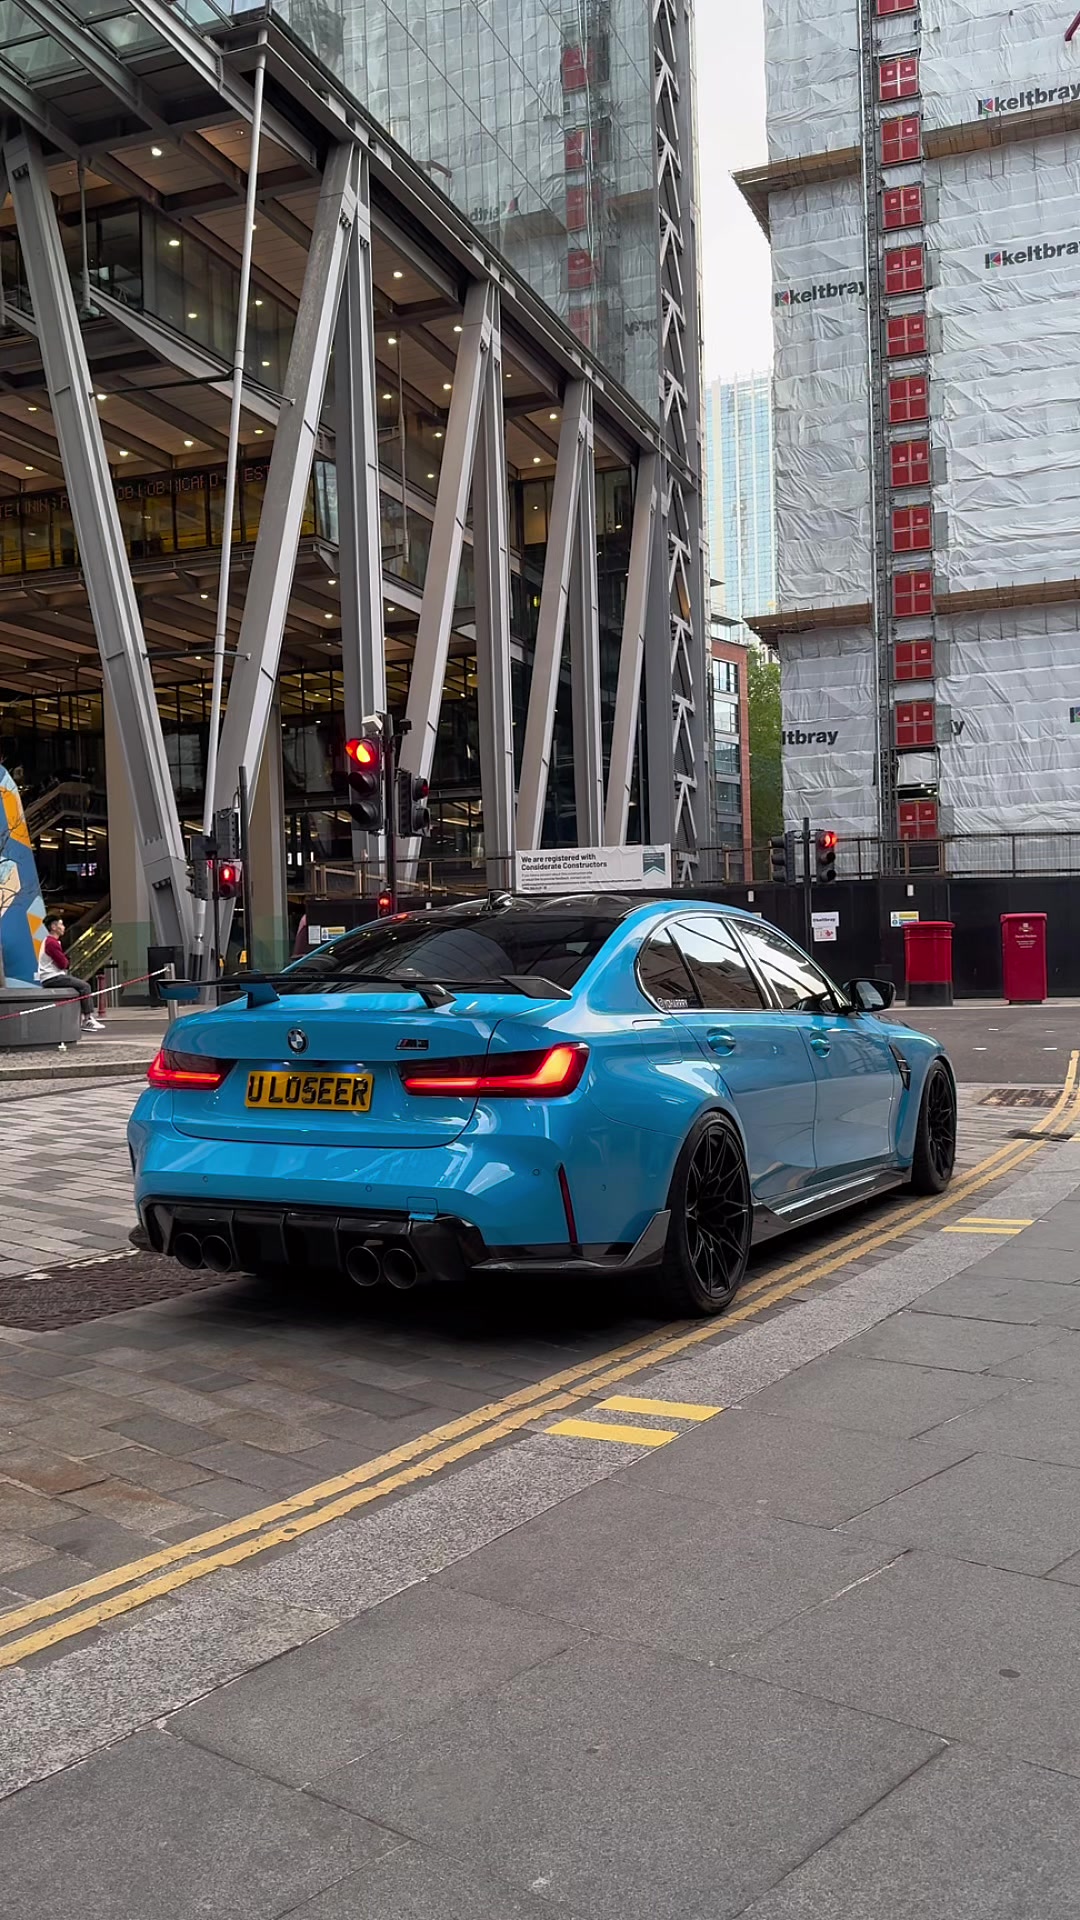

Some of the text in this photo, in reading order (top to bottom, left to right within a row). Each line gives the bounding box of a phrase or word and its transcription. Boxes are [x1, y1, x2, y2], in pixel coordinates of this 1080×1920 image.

[994, 83, 1080, 113] keltbray
[1002, 240, 1080, 266] keltbra
[789, 280, 865, 304] keltbray
[782, 730, 838, 746] ltbray
[521, 861, 607, 871] Considerate Constructors
[545, 854, 580, 863] registered
[581, 853, 596, 861] with
